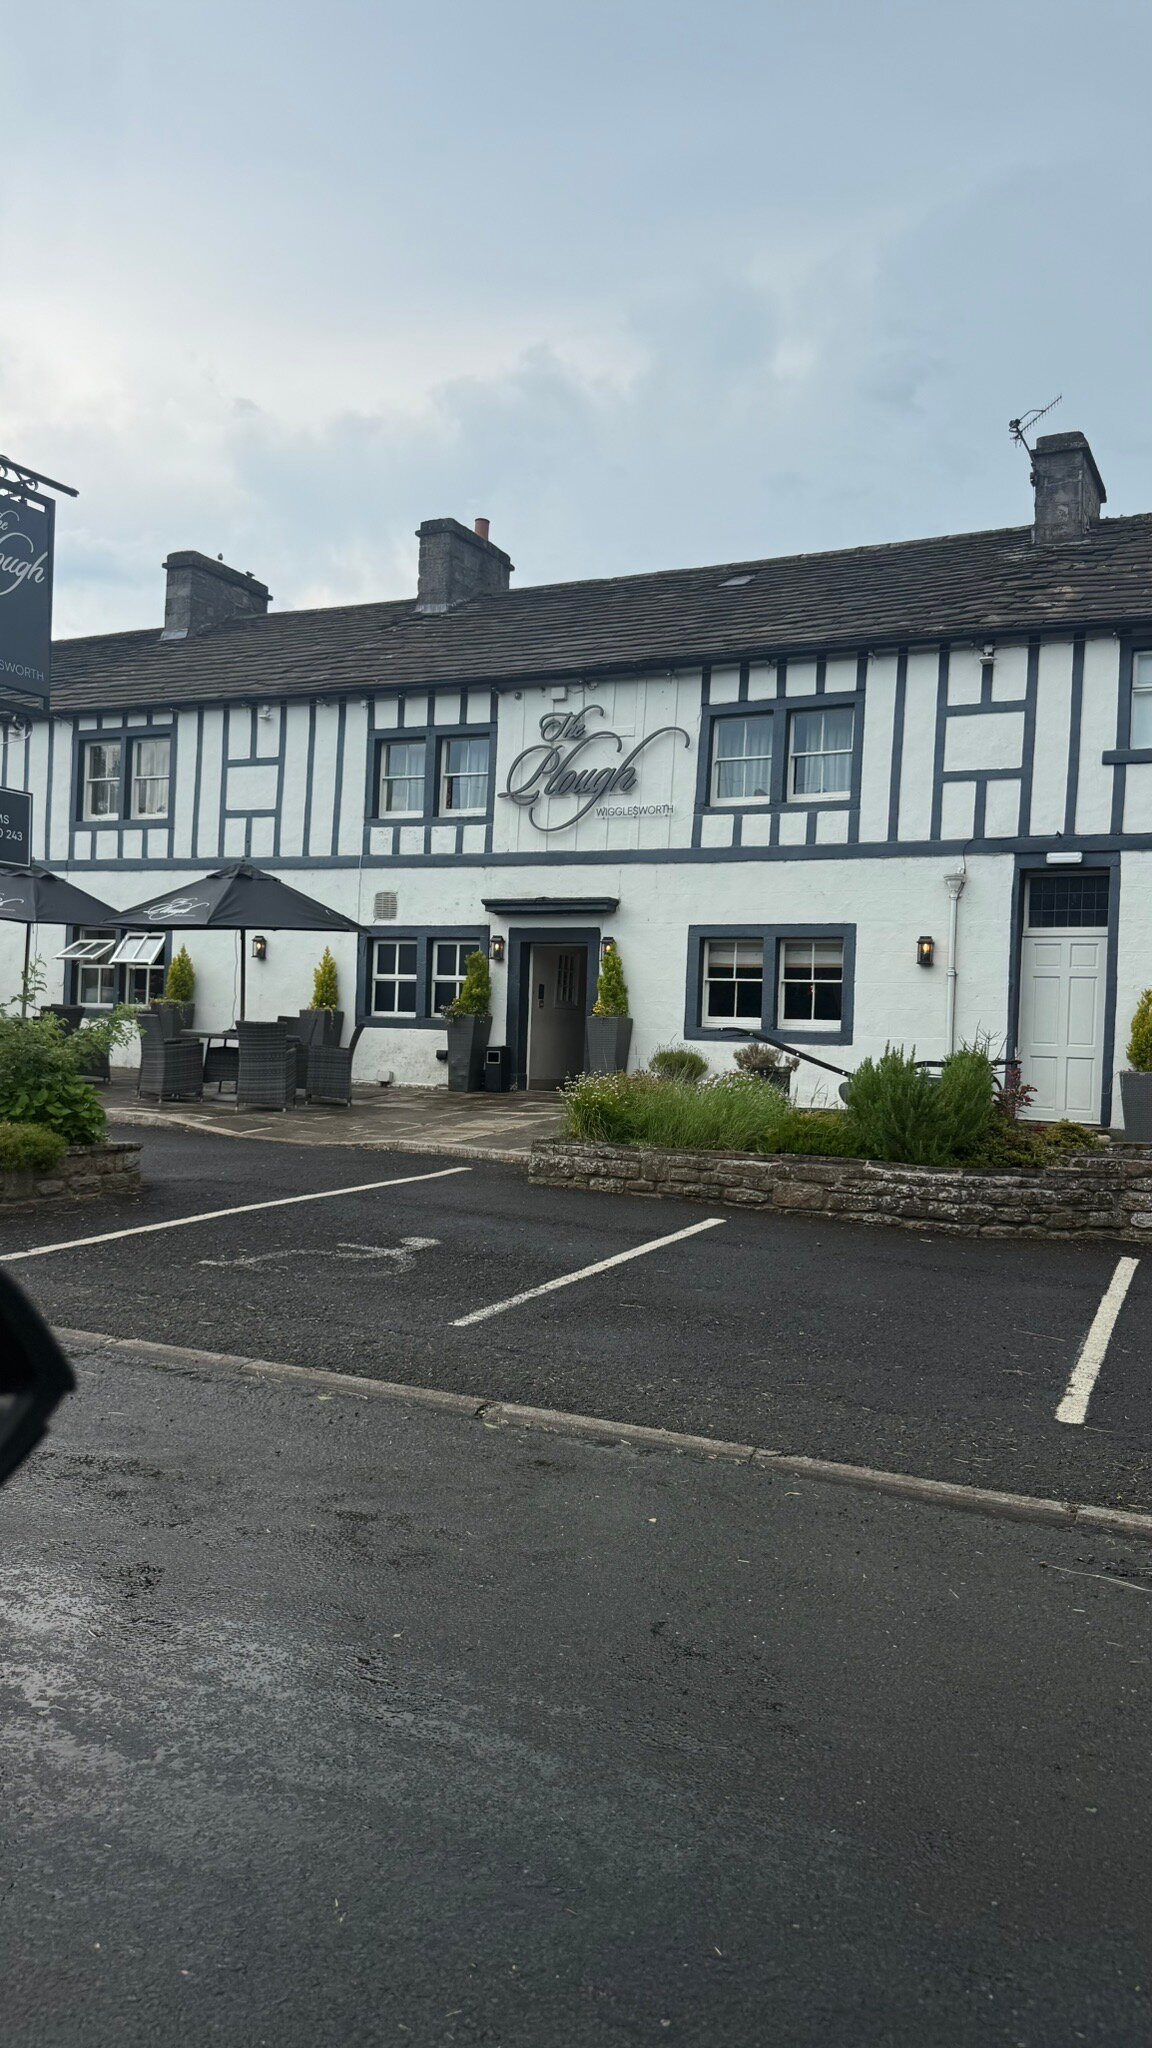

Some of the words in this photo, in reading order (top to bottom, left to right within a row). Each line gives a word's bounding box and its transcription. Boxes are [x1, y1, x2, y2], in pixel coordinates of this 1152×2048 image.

[539, 704, 605, 742] The
[497, 727, 690, 832] Plough
[596, 805, 674, 817] WIGGLESWORTH
[6, 829, 23, 841] 243
